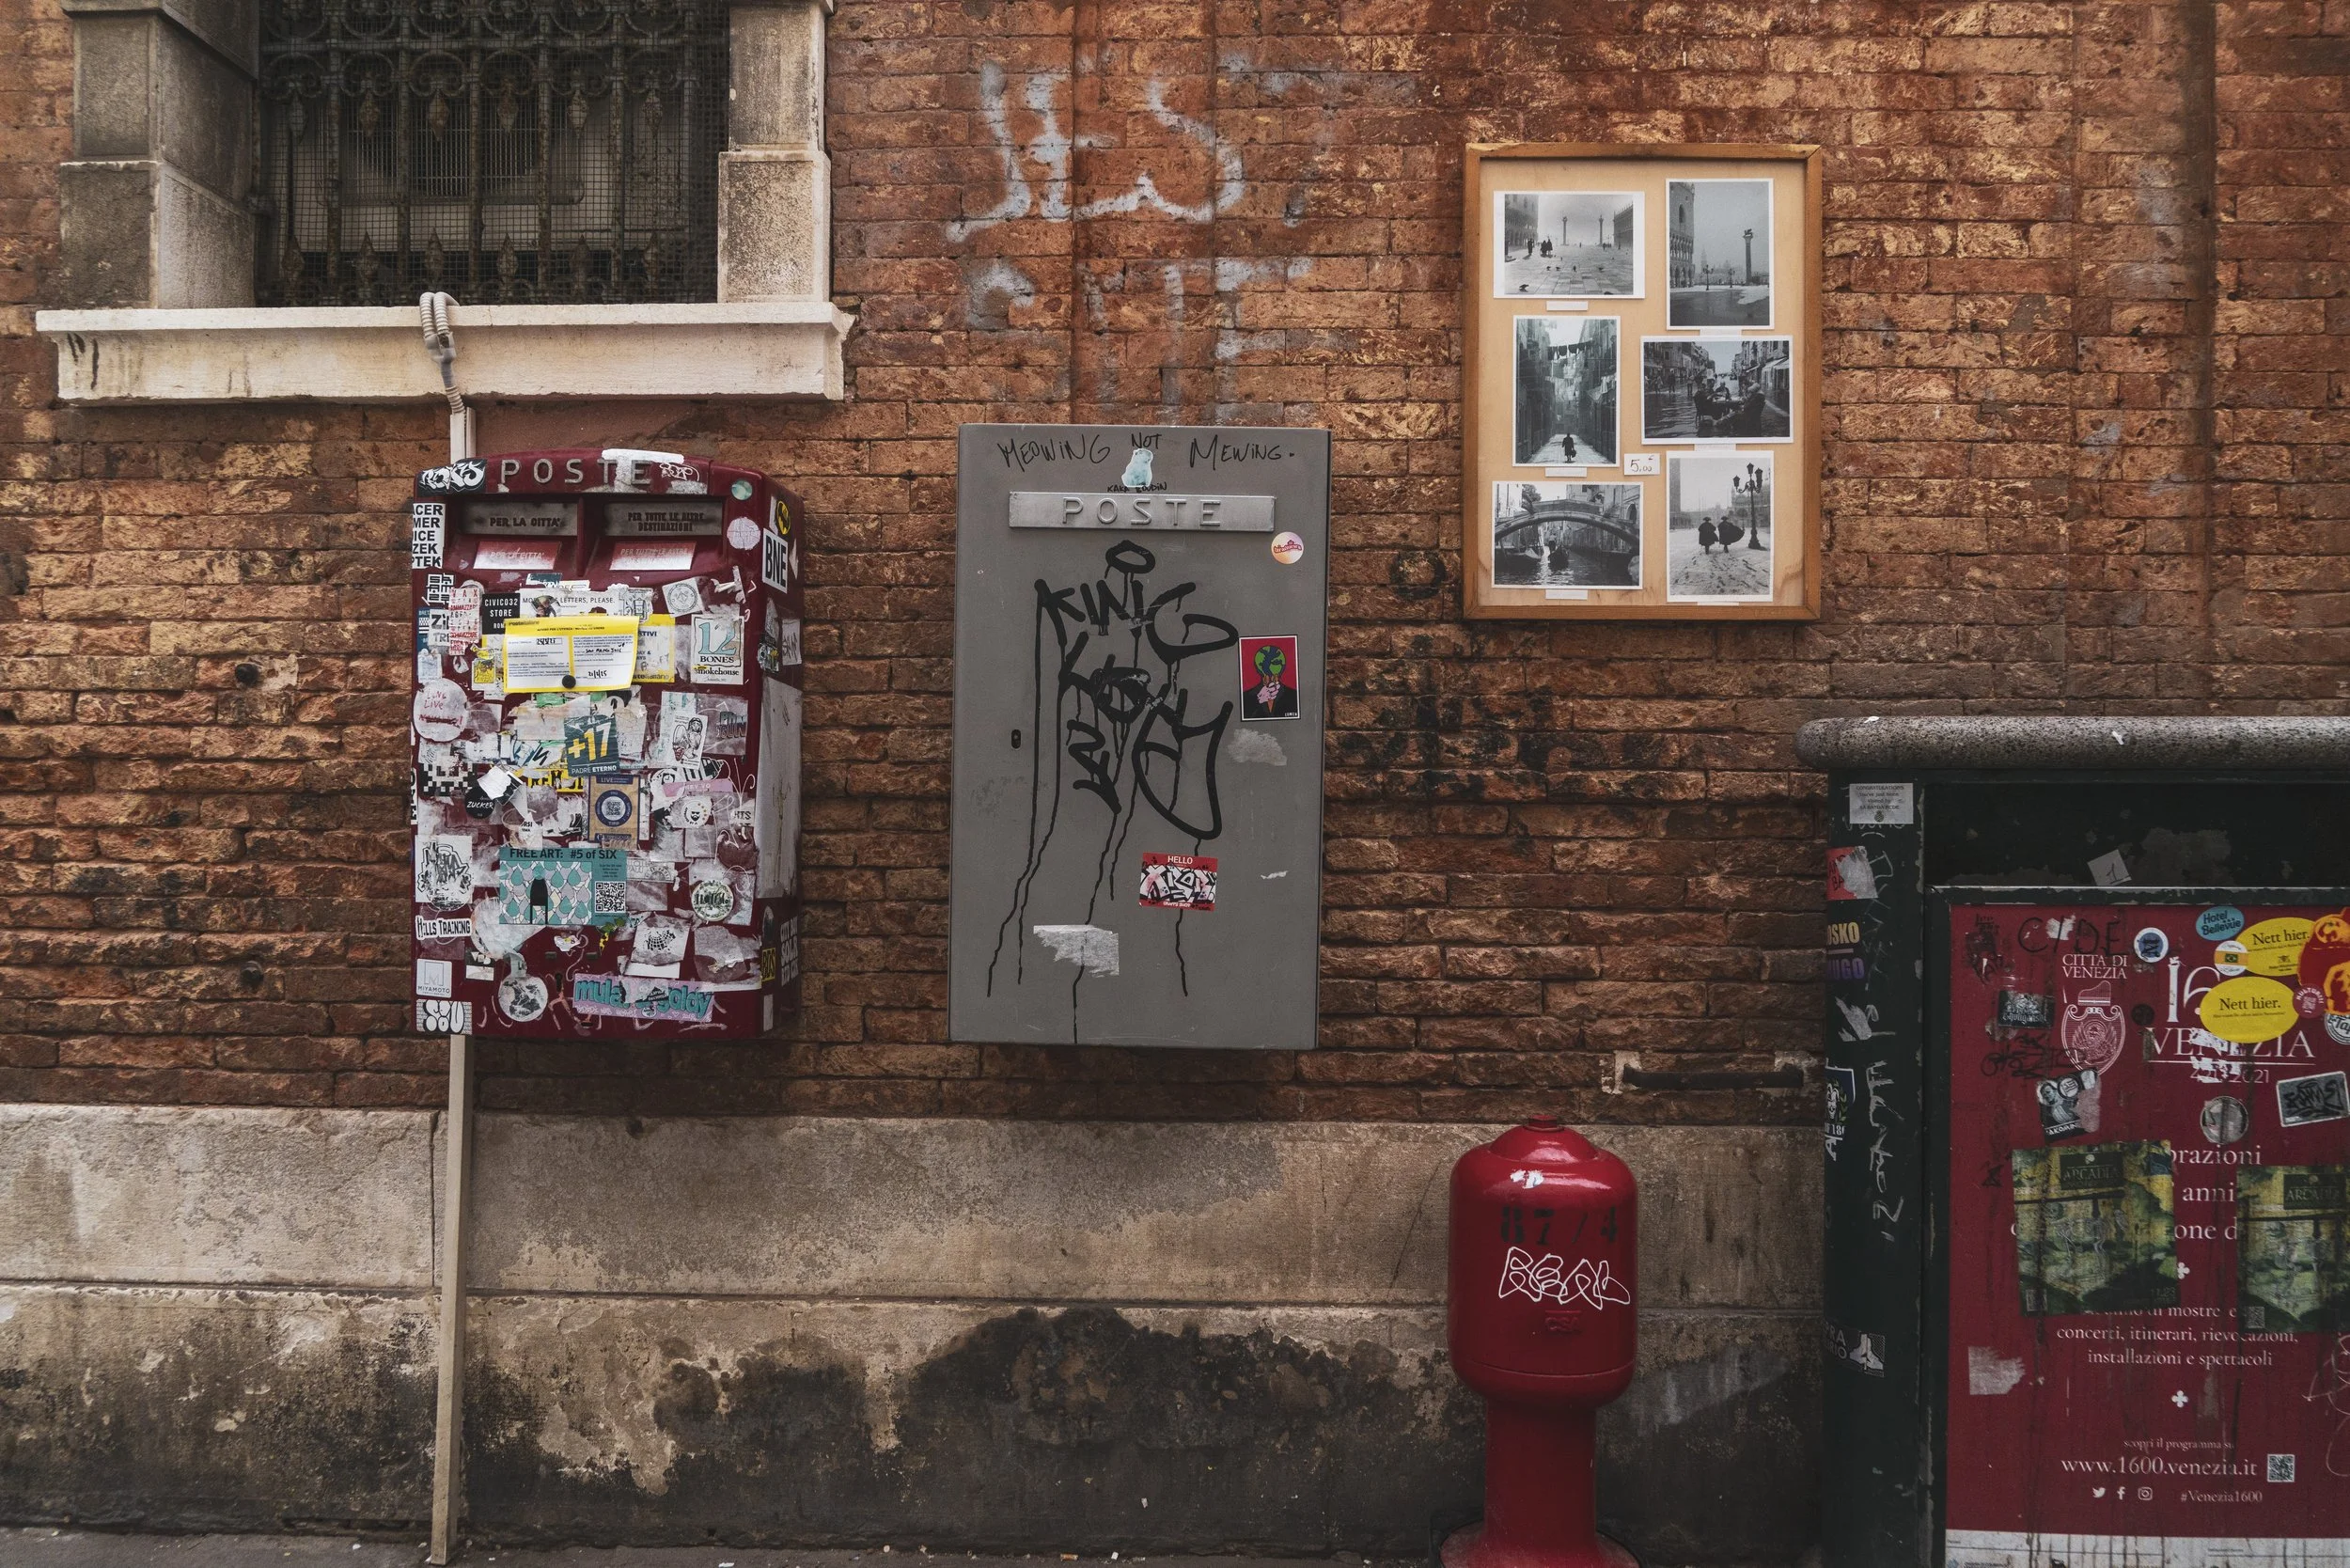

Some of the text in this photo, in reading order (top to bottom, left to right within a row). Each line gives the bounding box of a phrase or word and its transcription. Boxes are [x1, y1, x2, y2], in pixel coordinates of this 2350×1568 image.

[1131, 432, 1162, 449] NOT
[501, 458, 651, 485] POSTE
[628, 512, 705, 522] PER TUTTE LE ALTRE
[1062, 496, 1221, 526] POSTE
[490, 518, 510, 527] PER
[513, 518, 526, 527] LA
[637, 523, 694, 532] DESTINAZIONI
[765, 535, 788, 588] BNE
[484, 598, 519, 606] CIVICO32
[490, 609, 512, 618] STORE
[697, 621, 739, 656] 12
[699, 655, 735, 664] BONES
[568, 721, 612, 761] +17
[572, 764, 618, 775] PADRE ETERNO
[466, 801, 494, 809] ZUCKER
[509, 849, 617, 859] FREE ART: #5 of SIX
[1167, 855, 1194, 865] HELLO
[2203, 910, 2228, 924] Hotel
[2252, 929, 2311, 946] Nett hier.
[2112, 955, 2129, 967] DI
[2062, 966, 2127, 979] VENEZIA
[417, 985, 450, 994] MIYAMOTO
[2218, 996, 2281, 1011] Nett hier.
[2182, 1182, 2234, 1202] anni
[2056, 1326, 2125, 1341] concerti,
[2130, 1326, 2197, 1342] itinerari,
[2088, 1348, 2273, 1371] installazioni e spettacoli
[2123, 1439, 2154, 1454] scopri
[2155, 1437, 2163, 1449] il
[2060, 1456, 2258, 1476] www.1600.venezia.it
[2180, 1489, 2264, 1503] #Venezia1600
